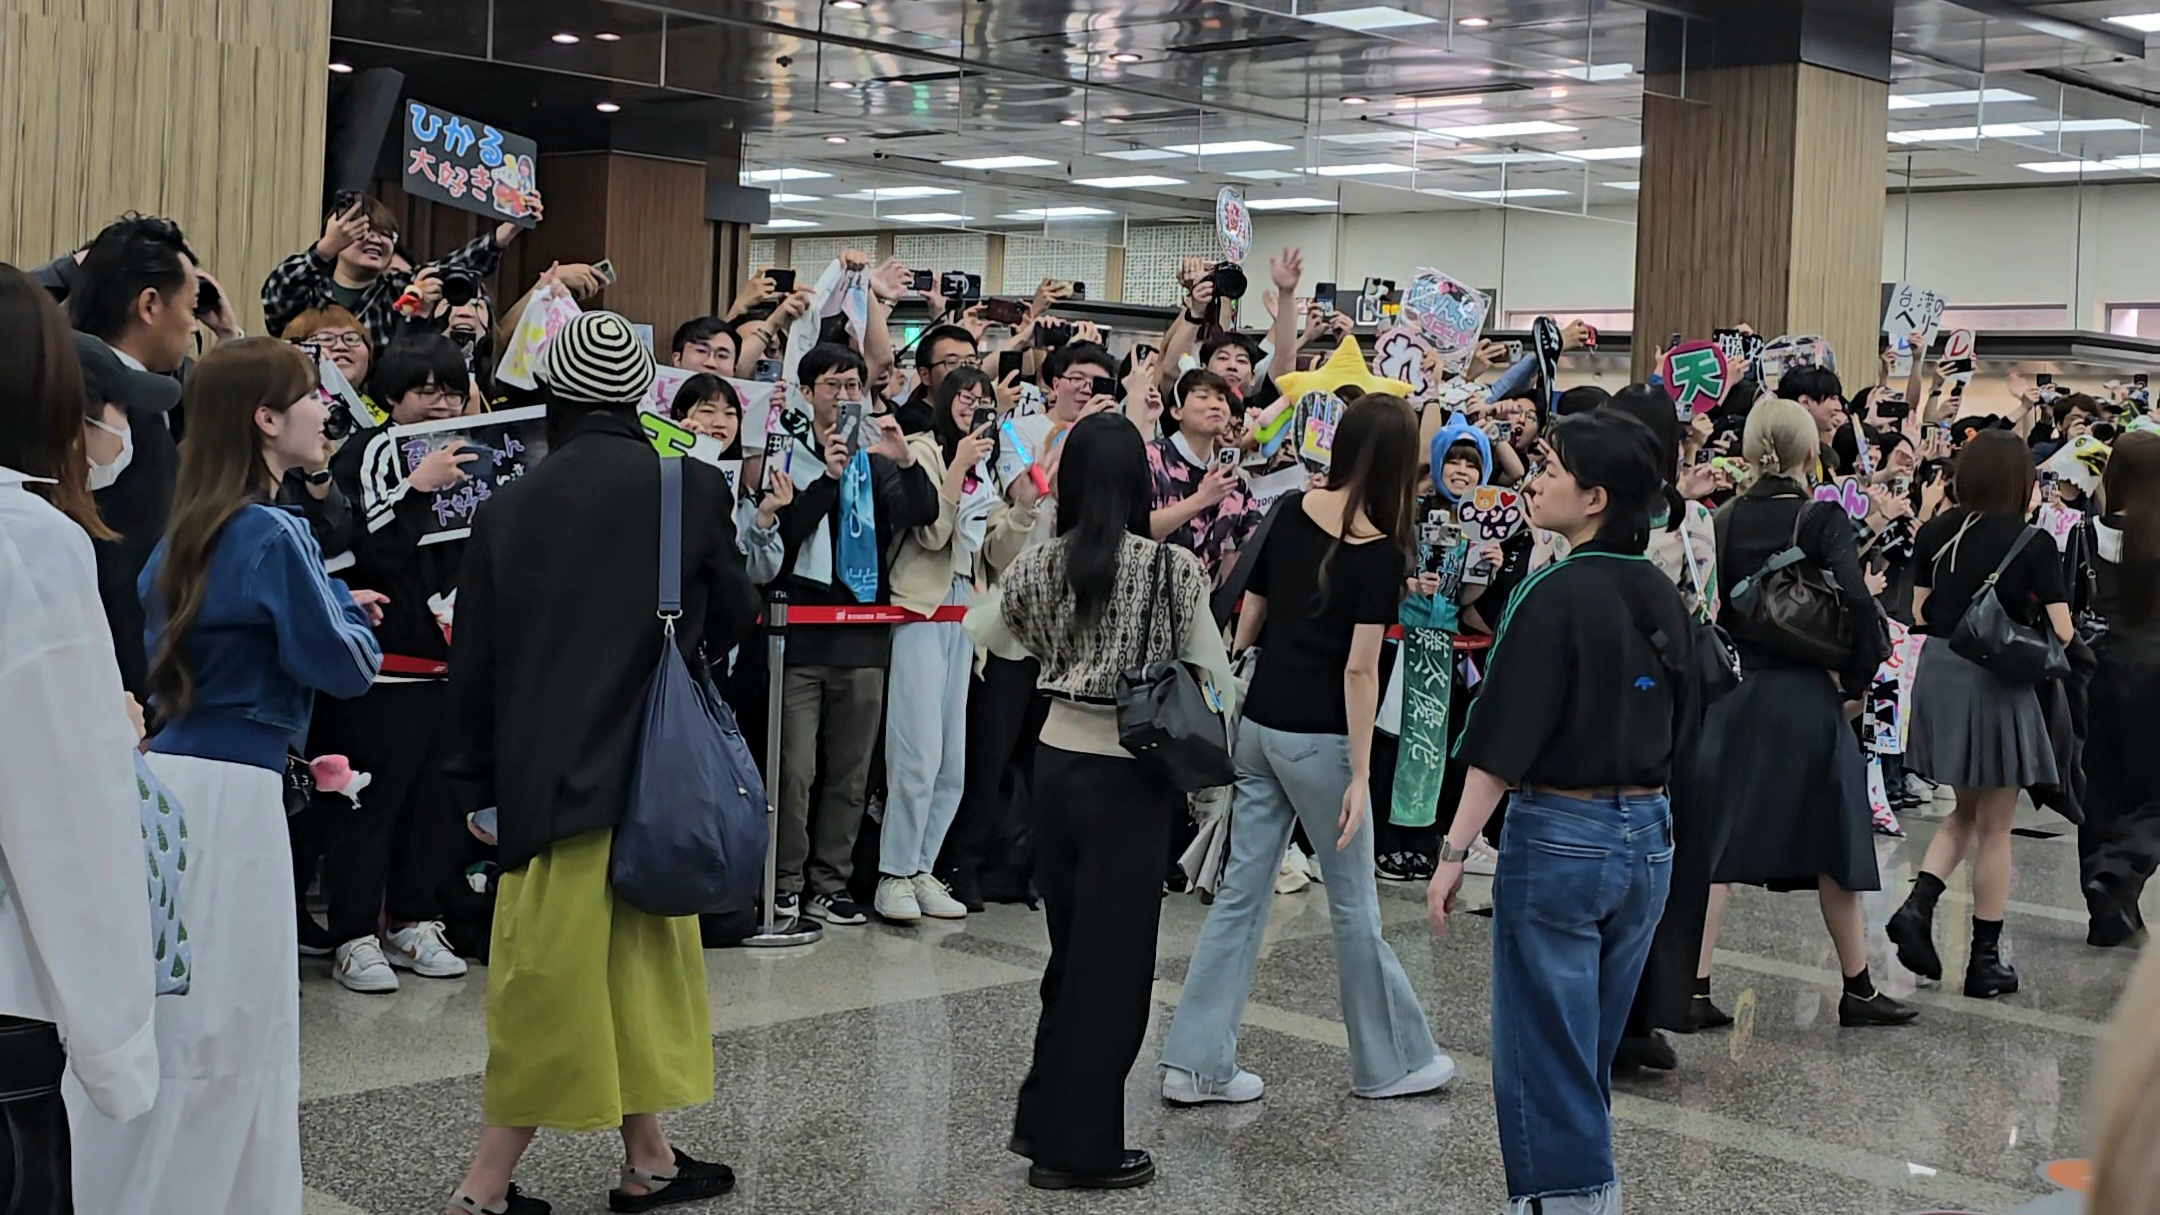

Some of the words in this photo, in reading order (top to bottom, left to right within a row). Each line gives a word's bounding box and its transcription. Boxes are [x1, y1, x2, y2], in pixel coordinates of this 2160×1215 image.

[410, 104, 504, 166] ひかる
[408, 147, 492, 202] 大好き
[1669, 347, 1724, 404] 天
